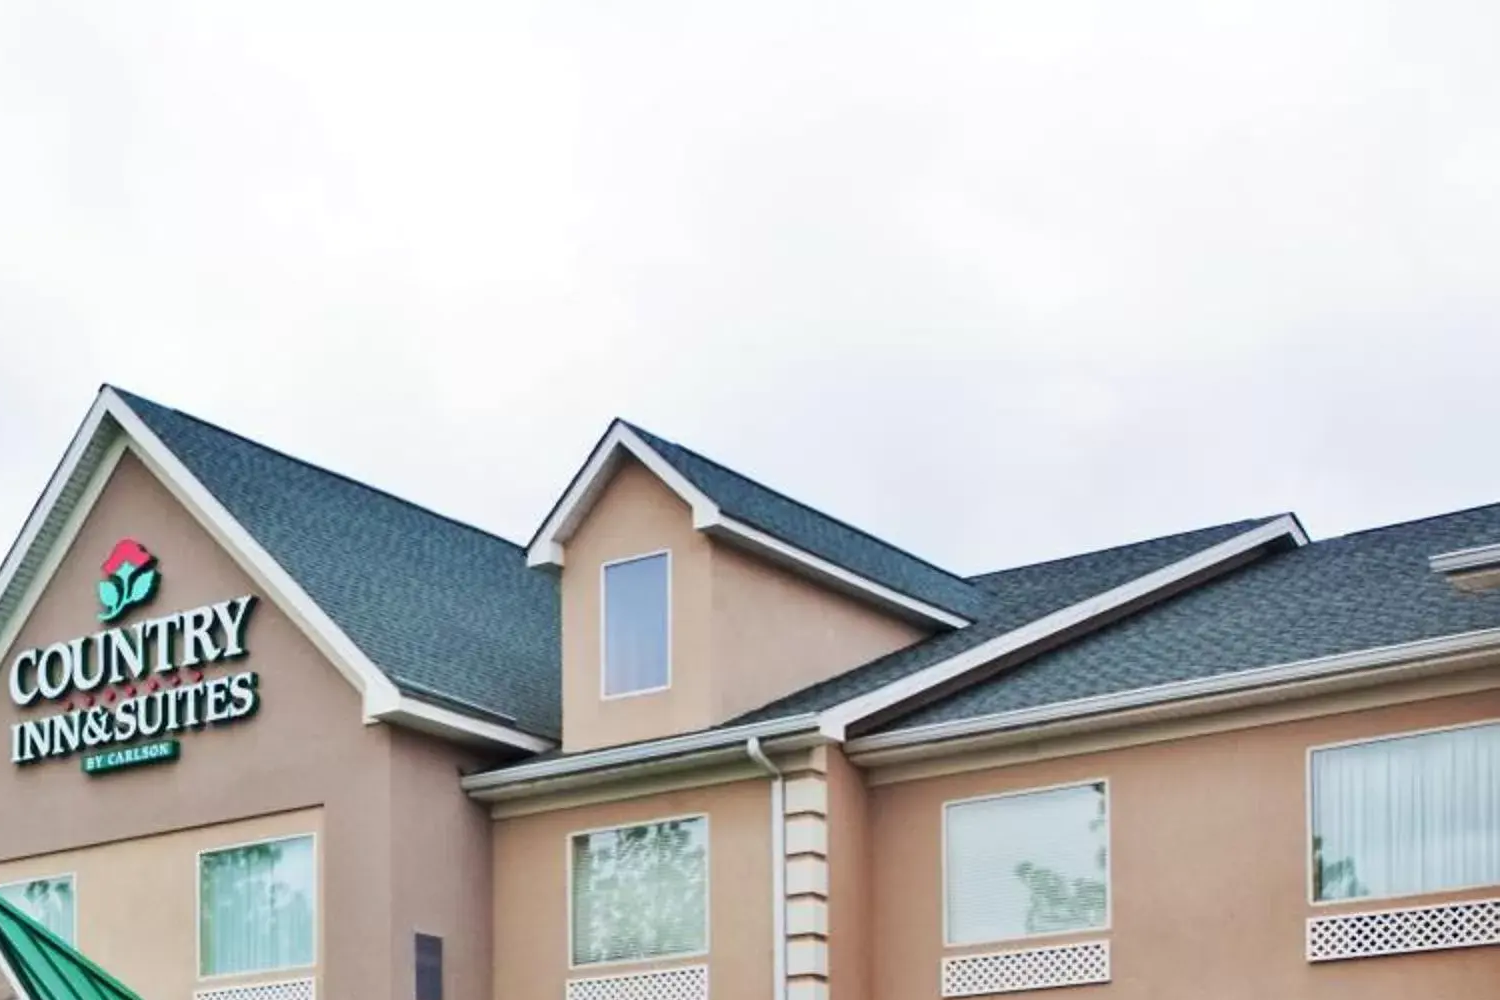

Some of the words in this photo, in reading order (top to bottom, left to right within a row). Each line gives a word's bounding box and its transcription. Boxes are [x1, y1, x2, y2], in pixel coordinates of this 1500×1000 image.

[9, 595, 252, 706] COUNTRY
[10, 671, 254, 763] INN&SUITES
[87, 755, 103, 771] BY
[108, 742, 169, 765] CARLSON
